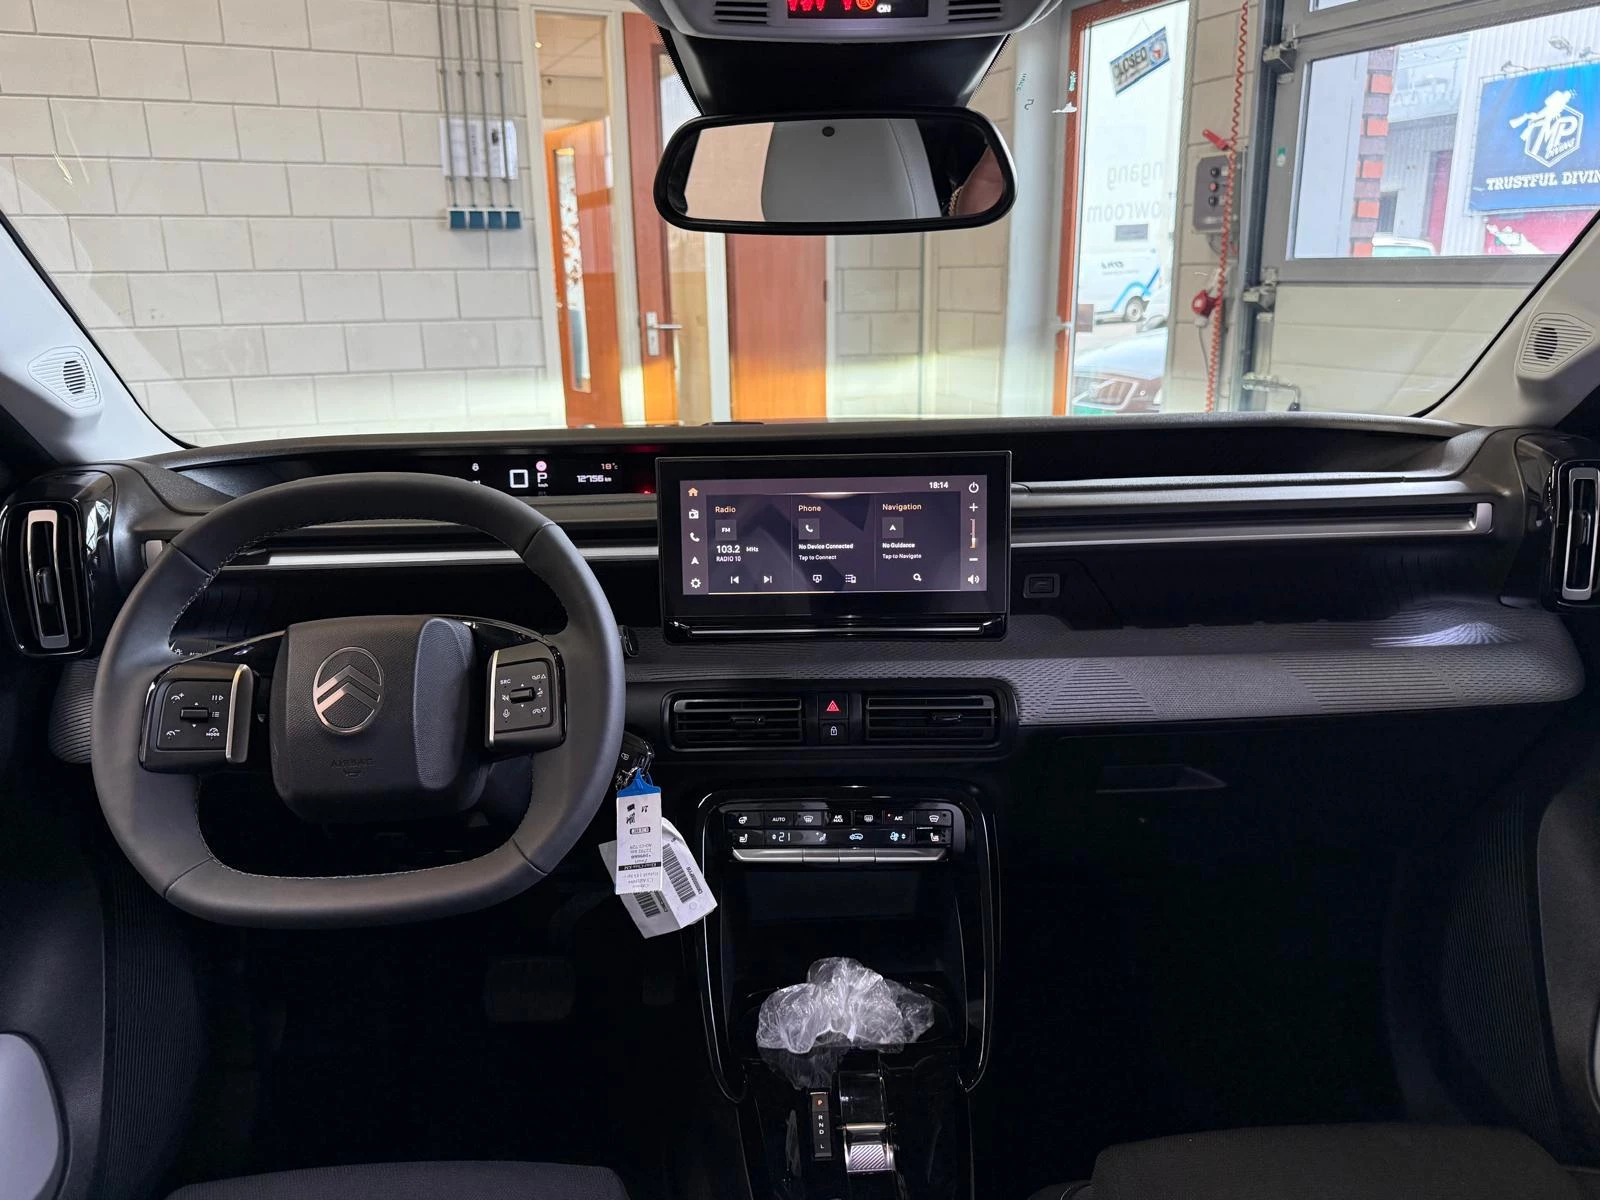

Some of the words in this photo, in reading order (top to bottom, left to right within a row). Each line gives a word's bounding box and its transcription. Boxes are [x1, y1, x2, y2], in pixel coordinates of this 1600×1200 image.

[876, 4, 891, 13] ON
[1486, 172, 1557, 190] TRUSTFUL
[537, 472, 548, 483] P
[928, 481, 949, 489] 18:14
[715, 505, 736, 513] Radio
[798, 504, 822, 512] Phone
[882, 503, 922, 512] Navigation
[716, 545, 741, 554] 103.2
[825, 542, 854, 550] Connected
[799, 554, 809, 562] Tap
[898, 552, 922, 560] Navigate
[778, 831, 791, 842] 21
